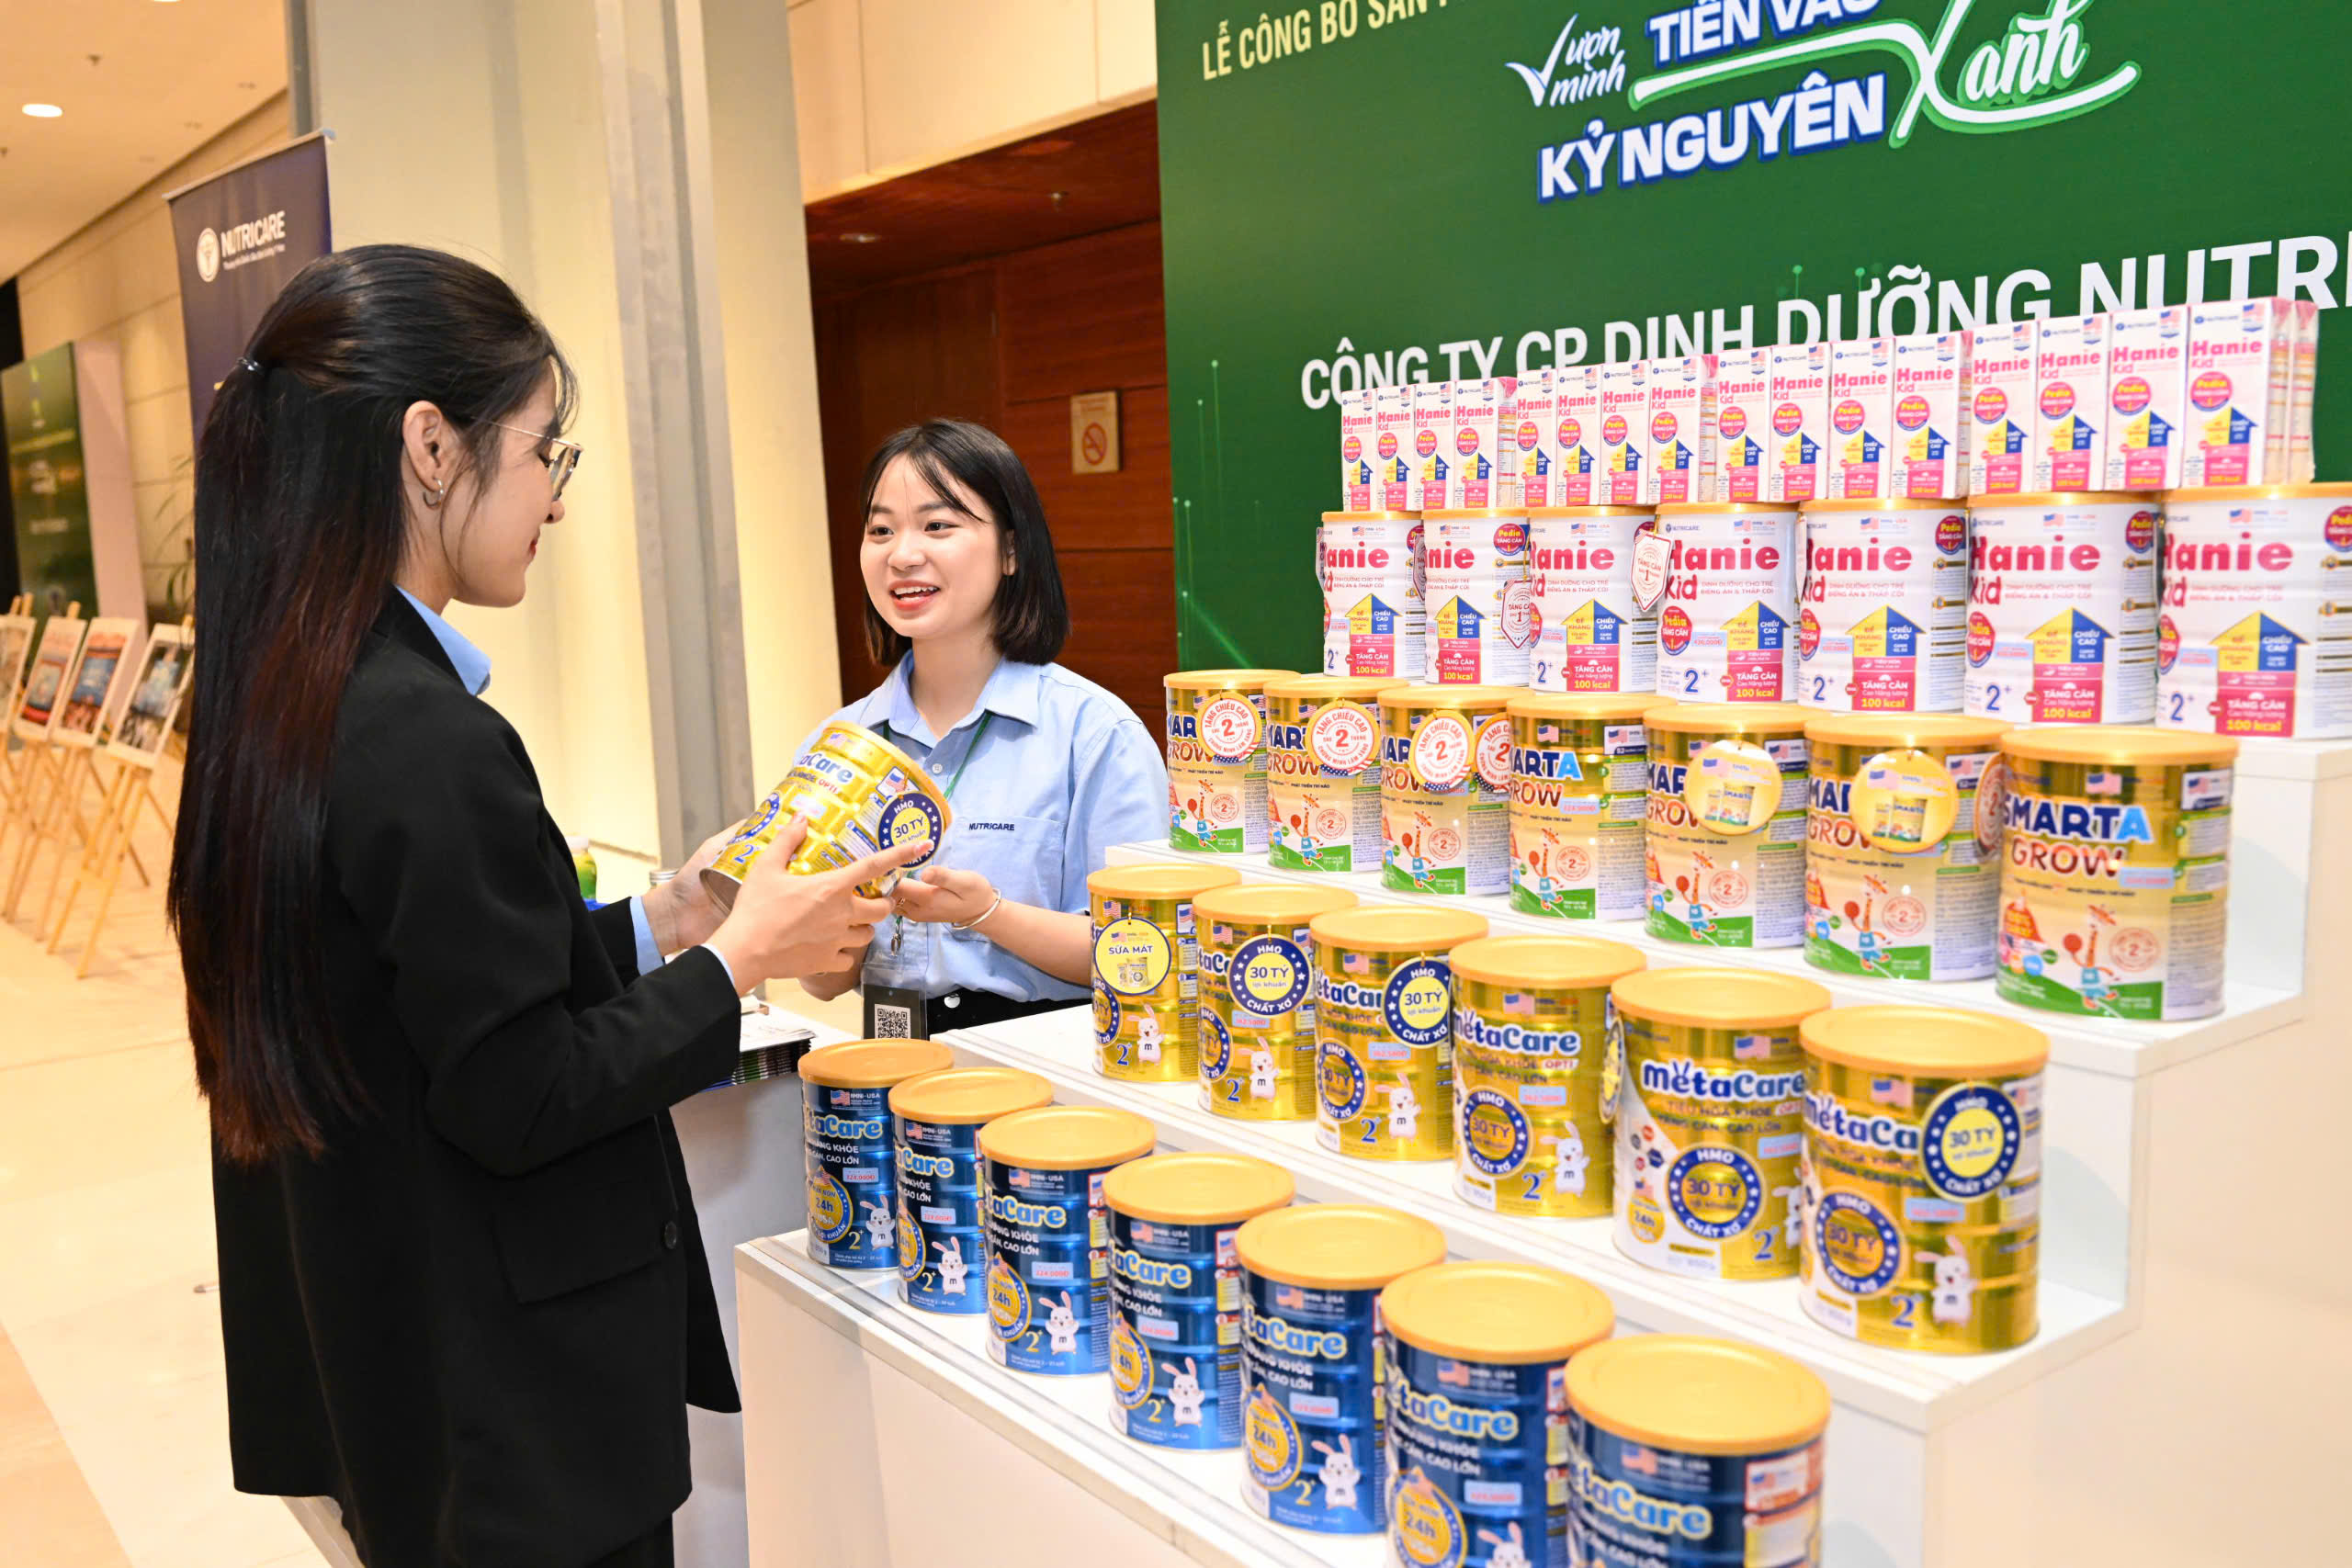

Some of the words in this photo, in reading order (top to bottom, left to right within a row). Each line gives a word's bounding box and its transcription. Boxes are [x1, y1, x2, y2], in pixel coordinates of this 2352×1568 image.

[1203, 18, 1232, 81] LỄ
[1239, 13, 1312, 70] CÔNG
[1550, 50, 1625, 107] mình
[1540, 118, 1616, 200] KỶ
[1621, 70, 1885, 185] NGUYÊN
[220, 210, 286, 258] NUTRICARE
[1301, 337, 1429, 409] CÔNG
[1440, 336, 1503, 380] TY
[1516, 326, 1588, 371] CP
[1605, 305, 1753, 364] DINH
[1776, 264, 2052, 344] DƯỠNG
[2113, 344, 2178, 362] Hanie
[2192, 338, 2262, 356] Hanie
[1973, 356, 2030, 374] Hanie
[2041, 350, 2100, 368] Hanie
[2192, 356, 2213, 369] Kid
[1896, 367, 1953, 382] Hanie
[2041, 367, 2059, 379] Kid
[2113, 363, 2134, 374] Kid
[1719, 378, 1765, 394] Hanie
[1773, 374, 1823, 390] Hanie
[1834, 371, 1887, 387] Hanie
[1973, 374, 1992, 385] Kid
[1652, 385, 1696, 400] Hanie
[1896, 382, 1915, 393] Kid
[1558, 393, 1596, 408] Hanie
[1603, 389, 1645, 403] Hanie
[1456, 405, 1494, 417] Hanie
[1517, 397, 1552, 412] Hanie
[1342, 414, 1373, 426] Hanie
[1377, 411, 1410, 423] Hanie
[1417, 407, 1451, 420] Hanie
[1940, 523, 1962, 533] Pedia
[1971, 535, 2101, 571] Hanie
[1664, 573, 1698, 601] Kid
[1663, 615, 1687, 626] Pedia
[2077, 637, 2098, 646] CAO
[2265, 643, 2290, 652] CAO
[1371, 666, 1387, 674] kcal
[1459, 671, 1473, 680] kcal
[1574, 665, 1595, 673] TĂNG
[1596, 665, 1613, 673] CÂN
[1758, 671, 1777, 680] CÂN
[1574, 680, 1592, 689] 100
[1592, 680, 1611, 689] kcal
[1861, 681, 1886, 690] TĂNG
[1888, 681, 1909, 690] CÂN
[1736, 689, 1756, 697] 100
[1756, 688, 1775, 697] kcal
[2042, 689, 2070, 699] TĂNG
[2072, 689, 2096, 699] CÂN
[1860, 697, 1883, 707] 100
[1883, 697, 1905, 708] kcal
[2227, 699, 2258, 710] TĂNG
[2259, 700, 2287, 710] CÂN
[1204, 710, 1217, 728] TĂNG
[1236, 705, 1249, 719] CAO
[2042, 708, 2066, 718] 100
[2066, 707, 2092, 718] kcal
[1221, 718, 1236, 737] 2
[1316, 716, 1332, 736] TĂNG
[1354, 717, 1368, 733] CAO
[1450, 725, 1463, 739] CAO
[2226, 718, 2252, 730] 100
[2254, 718, 2283, 731] kcal
[1335, 728, 1349, 748] 2
[1435, 739, 1449, 761] 2
[1495, 742, 1510, 763] 2
[893, 799, 914, 814] HMO
[894, 823, 910, 840] 30
[910, 814, 926, 830] TỶ
[968, 822, 1015, 831] NUTRICARE
[2010, 837, 2124, 877] GROW
[1108, 944, 1130, 955] SỮA
[1132, 943, 1153, 954] MÁT
[1257, 944, 1283, 954] HMO
[1250, 966, 1268, 979] 30
[1270, 964, 1290, 979] TỶ
[1409, 967, 1437, 979] HMO
[1404, 991, 1423, 1006] 30
[1424, 987, 1443, 1004] TỶ
[1246, 998, 1275, 1013] CHẤT
[1276, 997, 1293, 1010] XƠ
[1401, 1027, 1431, 1043] CHẤT
[1432, 1022, 1448, 1040] XƠ
[1324, 1042, 1346, 1057] HMO
[1544, 1059, 1576, 1069] OPTI
[1477, 1090, 1506, 1109] HMO
[1954, 1096, 1989, 1111] HMO
[1471, 1116, 1489, 1134] 30
[1490, 1121, 1510, 1138] TỶ
[1949, 1130, 1972, 1148] 30
[1974, 1124, 1996, 1144] TỶ
[826, 1155, 842, 1164] CAO
[842, 1156, 860, 1165] LỚN
[1696, 1148, 1736, 1164] HMO
[1685, 1177, 1711, 1195] 30
[1714, 1177, 1742, 1199] TỶ
[916, 1191, 932, 1202] LỚN
[1835, 1193, 1871, 1215] HMO
[815, 1197, 833, 1213] 24h
[817, 1213, 835, 1225] USA
[1685, 1217, 1721, 1237] CHẤT
[1828, 1222, 1849, 1242] 30
[1003, 1241, 1020, 1253] CAO
[1021, 1245, 1040, 1256] LỚN
[993, 1286, 1011, 1307] 24h
[1124, 1299, 1142, 1313] CAO
[1268, 1371, 1289, 1386] CAO
[1252, 1425, 1277, 1450] 24h
[1425, 1452, 1453, 1470] CAO
